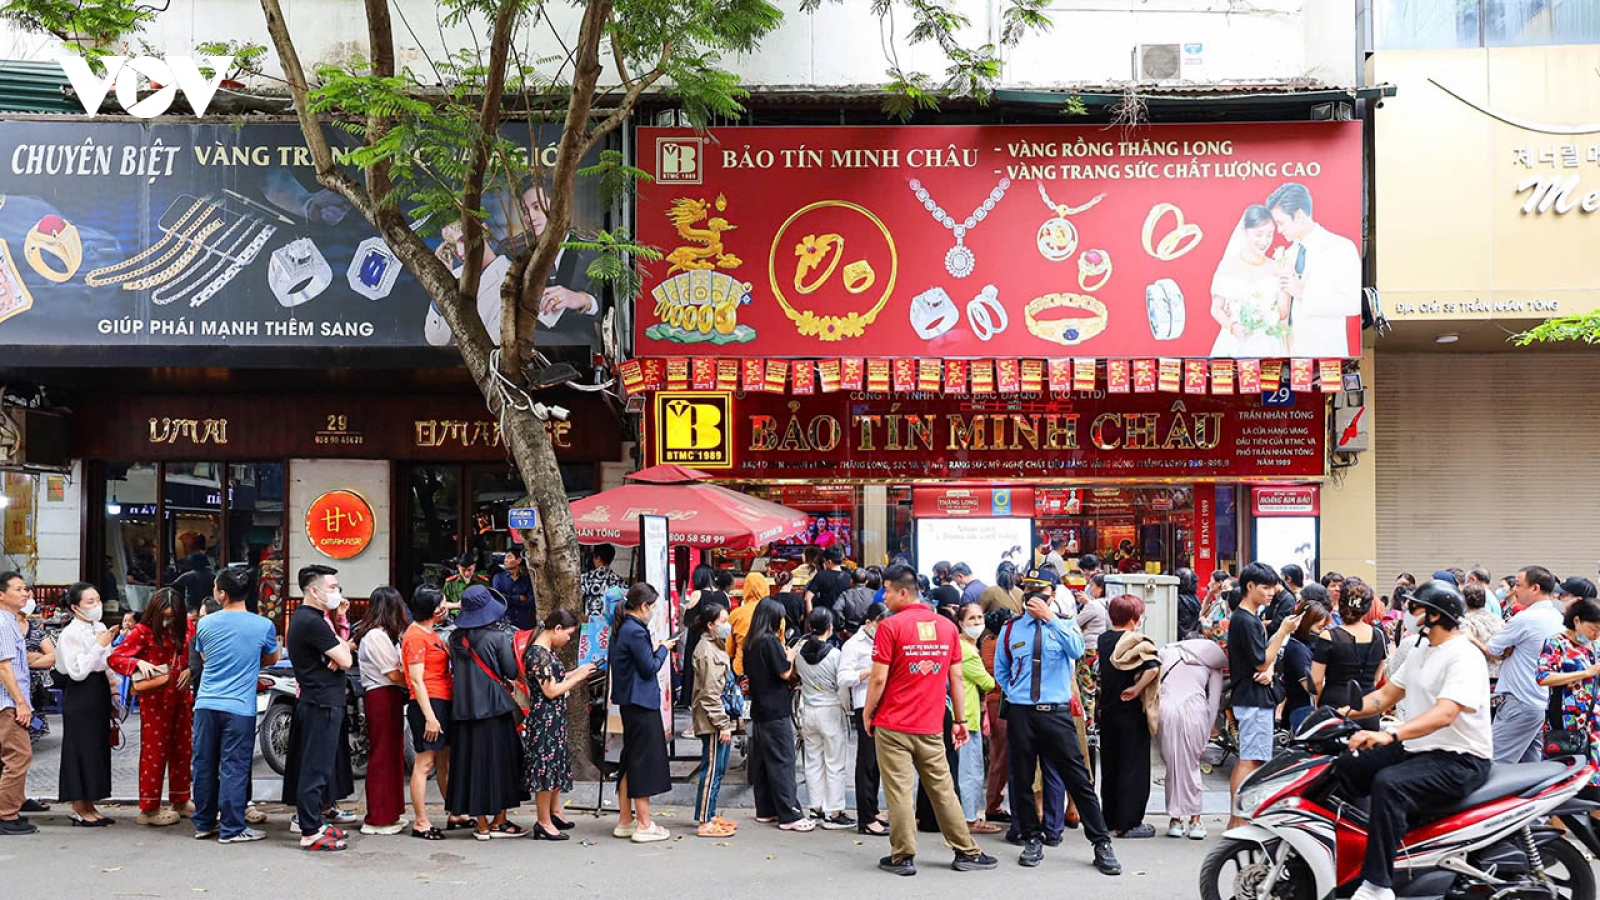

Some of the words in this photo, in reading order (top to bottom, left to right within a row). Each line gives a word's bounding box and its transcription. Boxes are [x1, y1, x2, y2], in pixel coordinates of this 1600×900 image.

[1007, 139, 1057, 157] VÀNG
[1060, 136, 1114, 157] RỒNG
[1118, 137, 1179, 157] THĂNG
[1183, 140, 1233, 156] LONG
[11, 136, 112, 176] CHUYÊN
[119, 137, 181, 184] BIỆT
[194, 140, 270, 166] VÀNG
[721, 143, 774, 169] BẢO
[780, 144, 823, 168] TÍN
[830, 149, 900, 168] MINH
[906, 143, 980, 168] CHÂU
[1007, 161, 1057, 180] VÀNG
[1060, 164, 1120, 180] TRANG
[1124, 160, 1160, 179] SỨC
[1163, 157, 1211, 178] CHẤT
[1214, 161, 1277, 181] LƯỢNG
[1281, 161, 1321, 177] CAO
[1443, 302, 1456, 313] 35
[1460, 298, 1490, 312] TRẦN
[1493, 300, 1523, 312] NHÂN
[1527, 299, 1561, 312] TÔNG
[97, 315, 144, 335] GIÚP
[150, 316, 195, 335] PHÁI
[201, 320, 259, 339] MẠNH
[264, 318, 315, 336] THÊM
[320, 321, 375, 336] SANG
[887, 390, 900, 400] TY
[904, 390, 935, 400] TNHH
[1079, 389, 1106, 400] LTD)
[1268, 387, 1290, 403] 29
[326, 414, 347, 431] 29
[1238, 409, 1261, 420] TRẦN
[1263, 409, 1288, 420] NHÂN
[1290, 409, 1314, 420] TÔNG
[149, 417, 228, 444] UMAI
[749, 400, 842, 451] BẢO
[852, 402, 937, 451] TÍN
[946, 413, 1080, 451] MINH
[1089, 400, 1225, 451] CHÂU
[1268, 426, 1288, 435] HÀNG
[1289, 426, 1309, 435] VÀNG
[1285, 438, 1305, 446] BTMC
[666, 450, 694, 461] BTMC
[698, 450, 722, 461] 1989
[1272, 448, 1293, 456] NHÂN
[1294, 447, 1315, 456] TÔNG
[1275, 458, 1291, 466] 1989
[1200, 499, 1210, 517] 1989
[320, 506, 364, 532] 甘い
[595, 528, 621, 538] TÔNG
[687, 533, 698, 543] 58
[700, 534, 711, 544] 58
[713, 535, 725, 545] 99
[1201, 518, 1210, 545] BTMC
